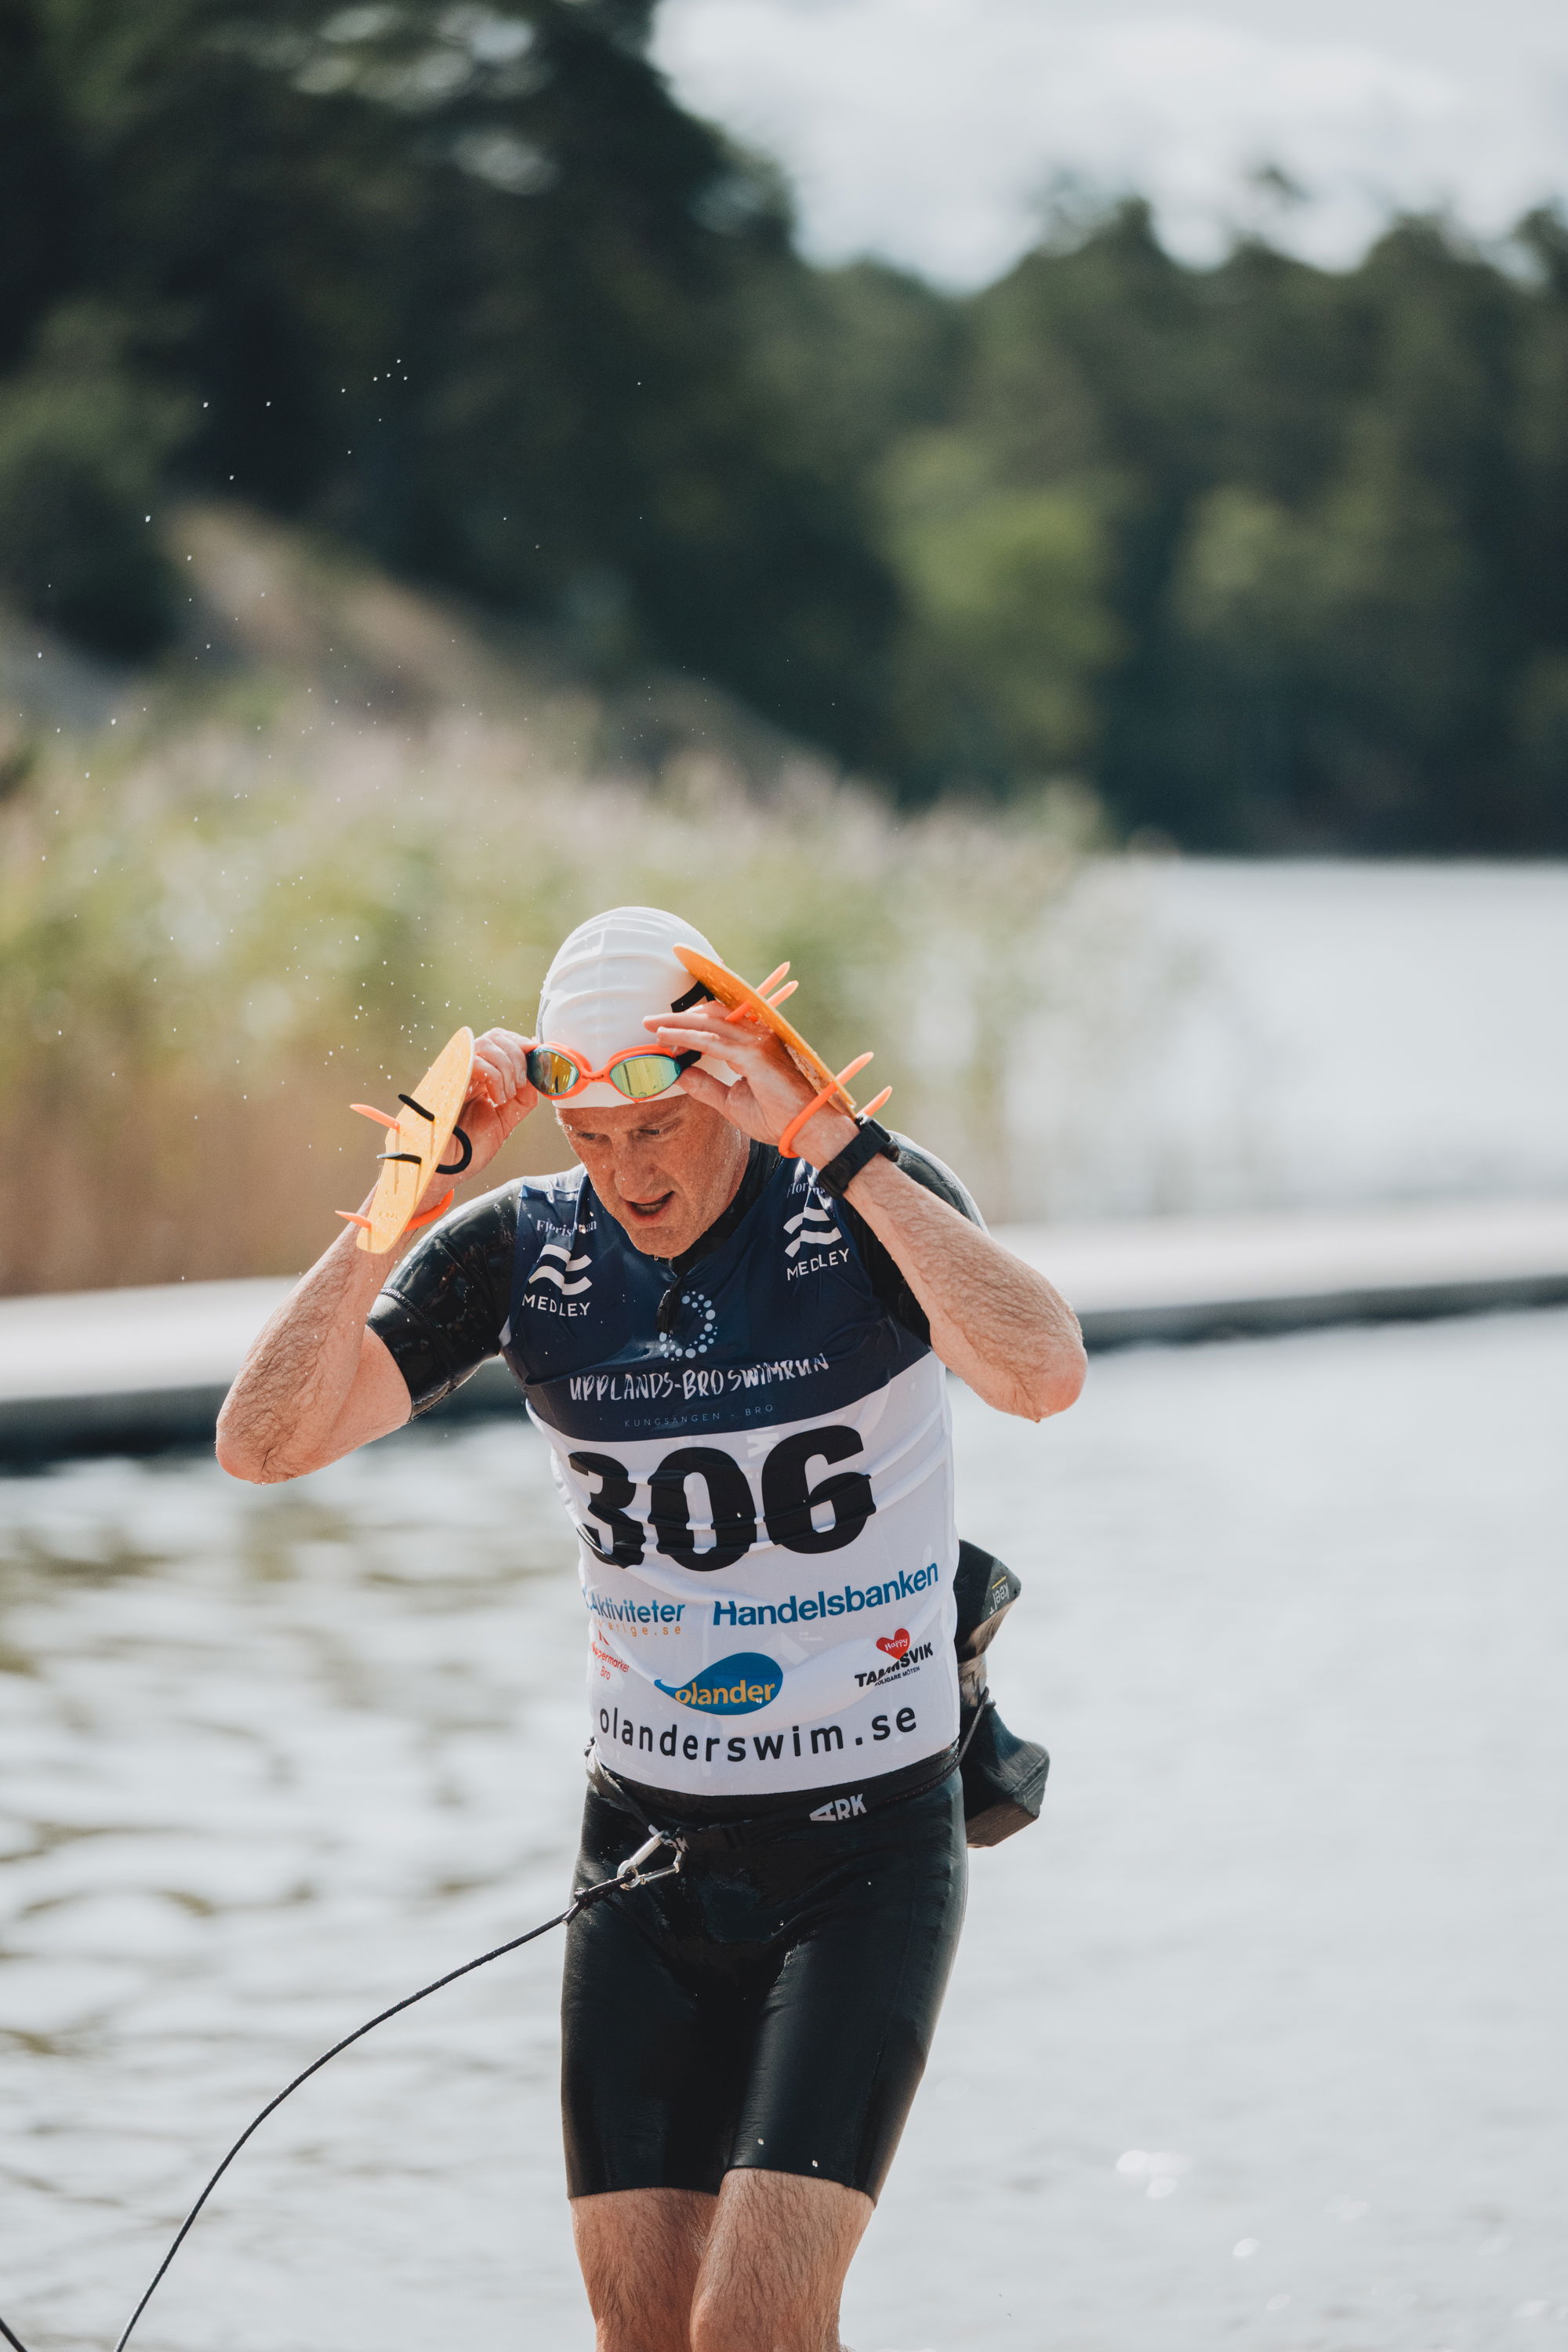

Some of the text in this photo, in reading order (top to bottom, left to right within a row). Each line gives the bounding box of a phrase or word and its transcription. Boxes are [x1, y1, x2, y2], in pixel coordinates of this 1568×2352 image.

[786, 1248, 850, 1281] MEDLEY
[521, 1293, 590, 1317] MEDLEY
[569, 1353, 829, 1401] UPPLANDS-BRO SWIMRUN
[624, 1412, 720, 1428] KUNGSANGEN
[745, 1404, 773, 1417] BRO
[568, 1425, 877, 1572] 306
[590, 1592, 686, 1624] Aktiviteter
[713, 1562, 939, 1626] Handelsbanken
[675, 1679, 775, 1707] olander
[600, 1706, 917, 1762] olanderswim.se
[809, 1793, 868, 1822] ARK
